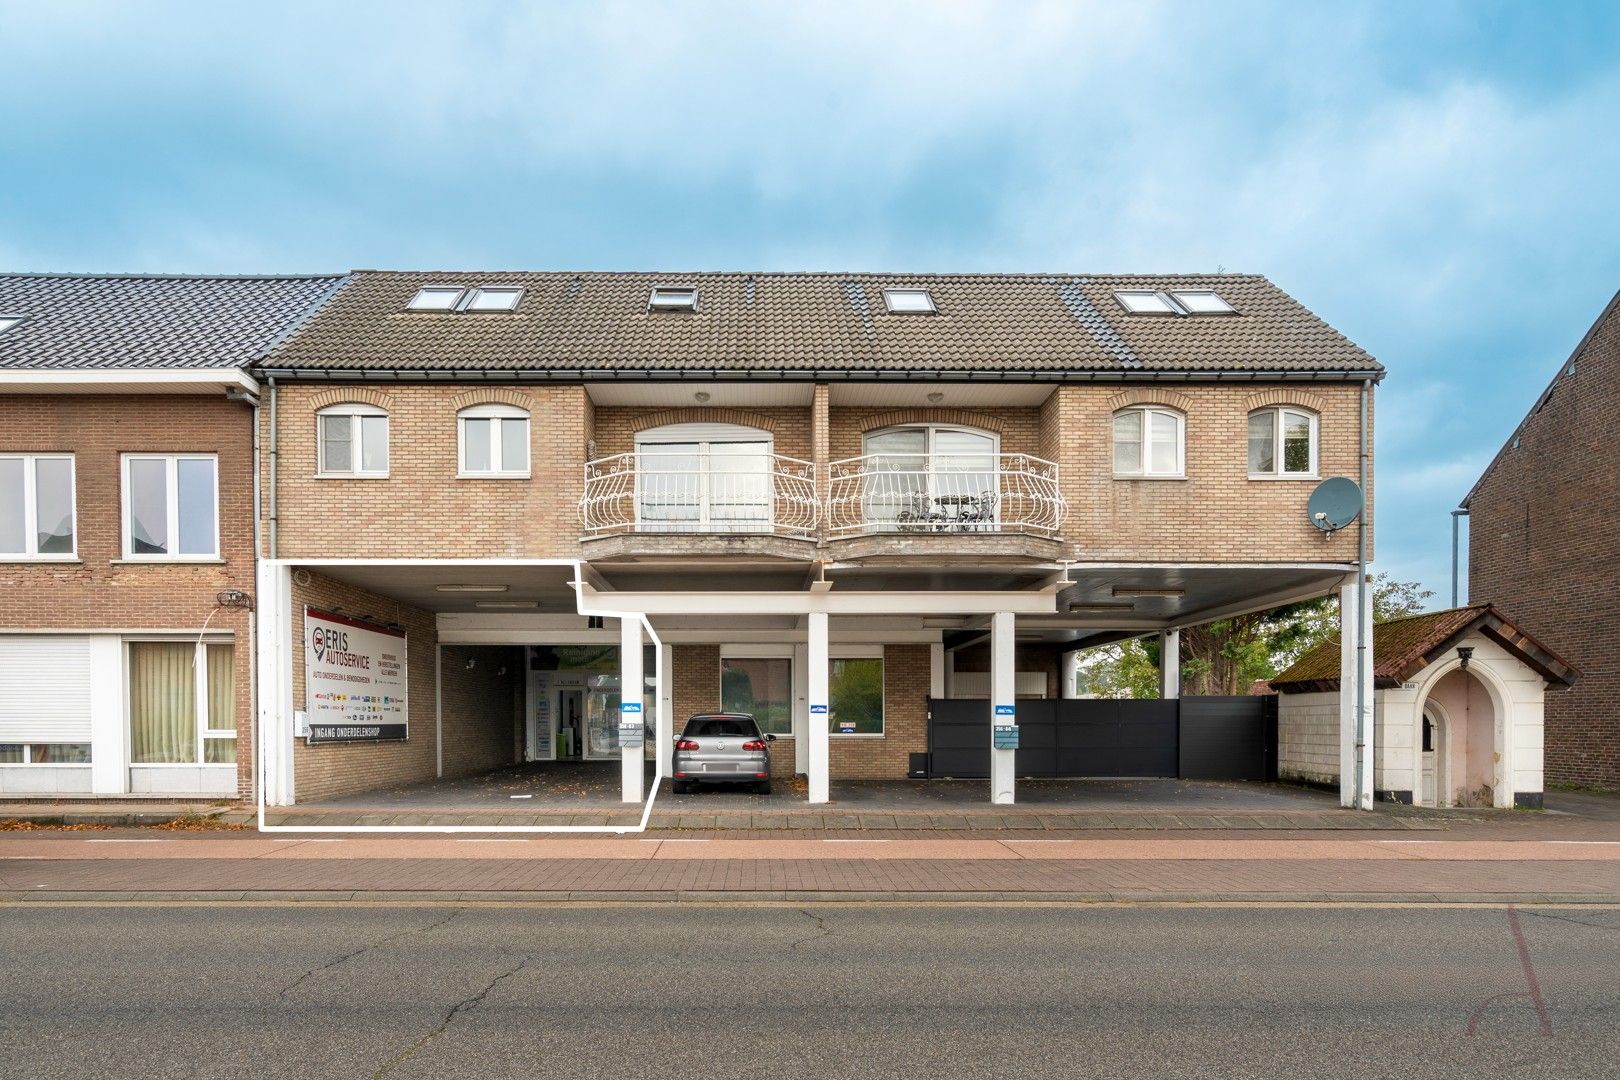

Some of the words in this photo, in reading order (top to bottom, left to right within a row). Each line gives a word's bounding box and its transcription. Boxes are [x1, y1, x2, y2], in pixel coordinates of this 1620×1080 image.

[326, 629, 348, 652] ERIS
[326, 650, 370, 670] AUTOSERVICE
[313, 670, 322, 679] AUTO
[322, 671, 344, 681] ONDERDELEN
[314, 727, 335, 738] INGANG
[336, 727, 380, 738] ONDERDELENSHOP
